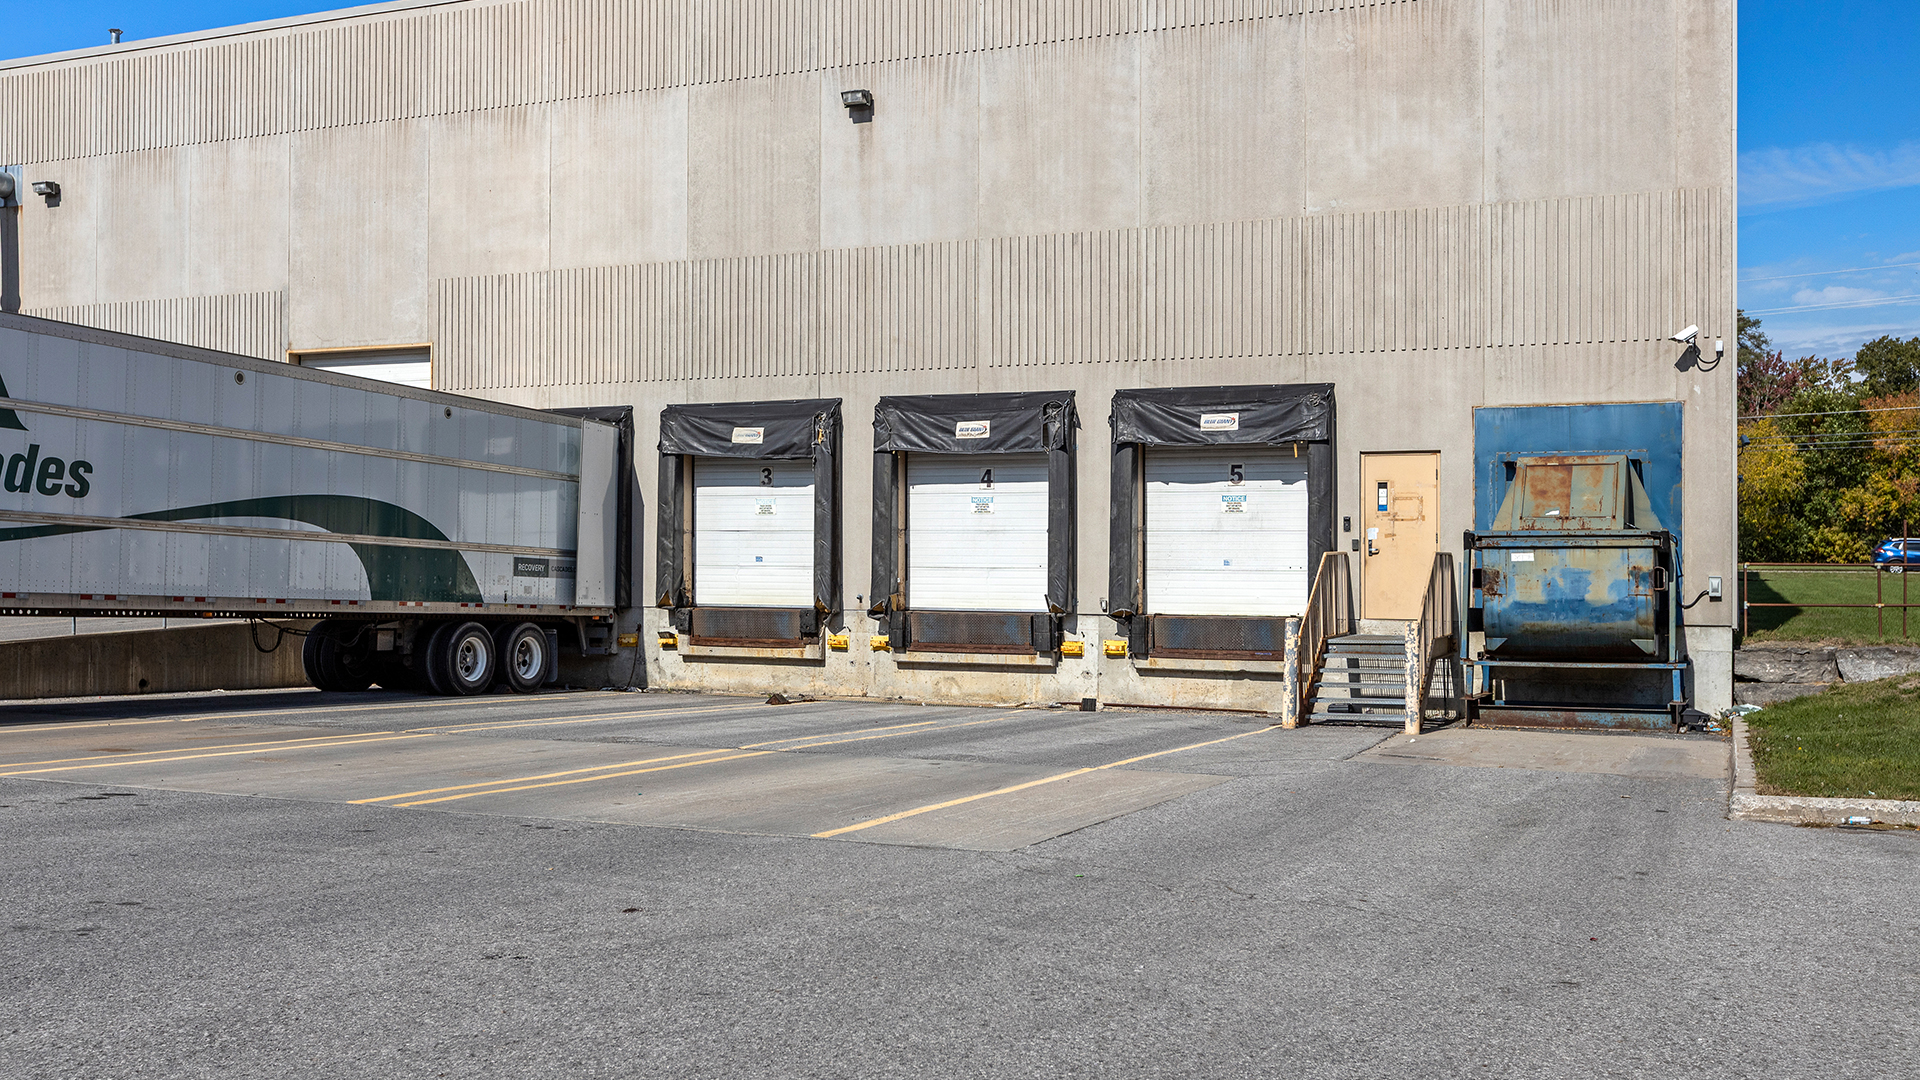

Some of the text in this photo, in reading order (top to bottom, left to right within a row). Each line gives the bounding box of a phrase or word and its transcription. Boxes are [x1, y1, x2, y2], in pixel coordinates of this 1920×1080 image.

[761, 468, 772, 486] 3
[980, 469, 993, 488] 4
[1230, 464, 1244, 484] 5
[517, 563, 546, 572] RECOVERY
